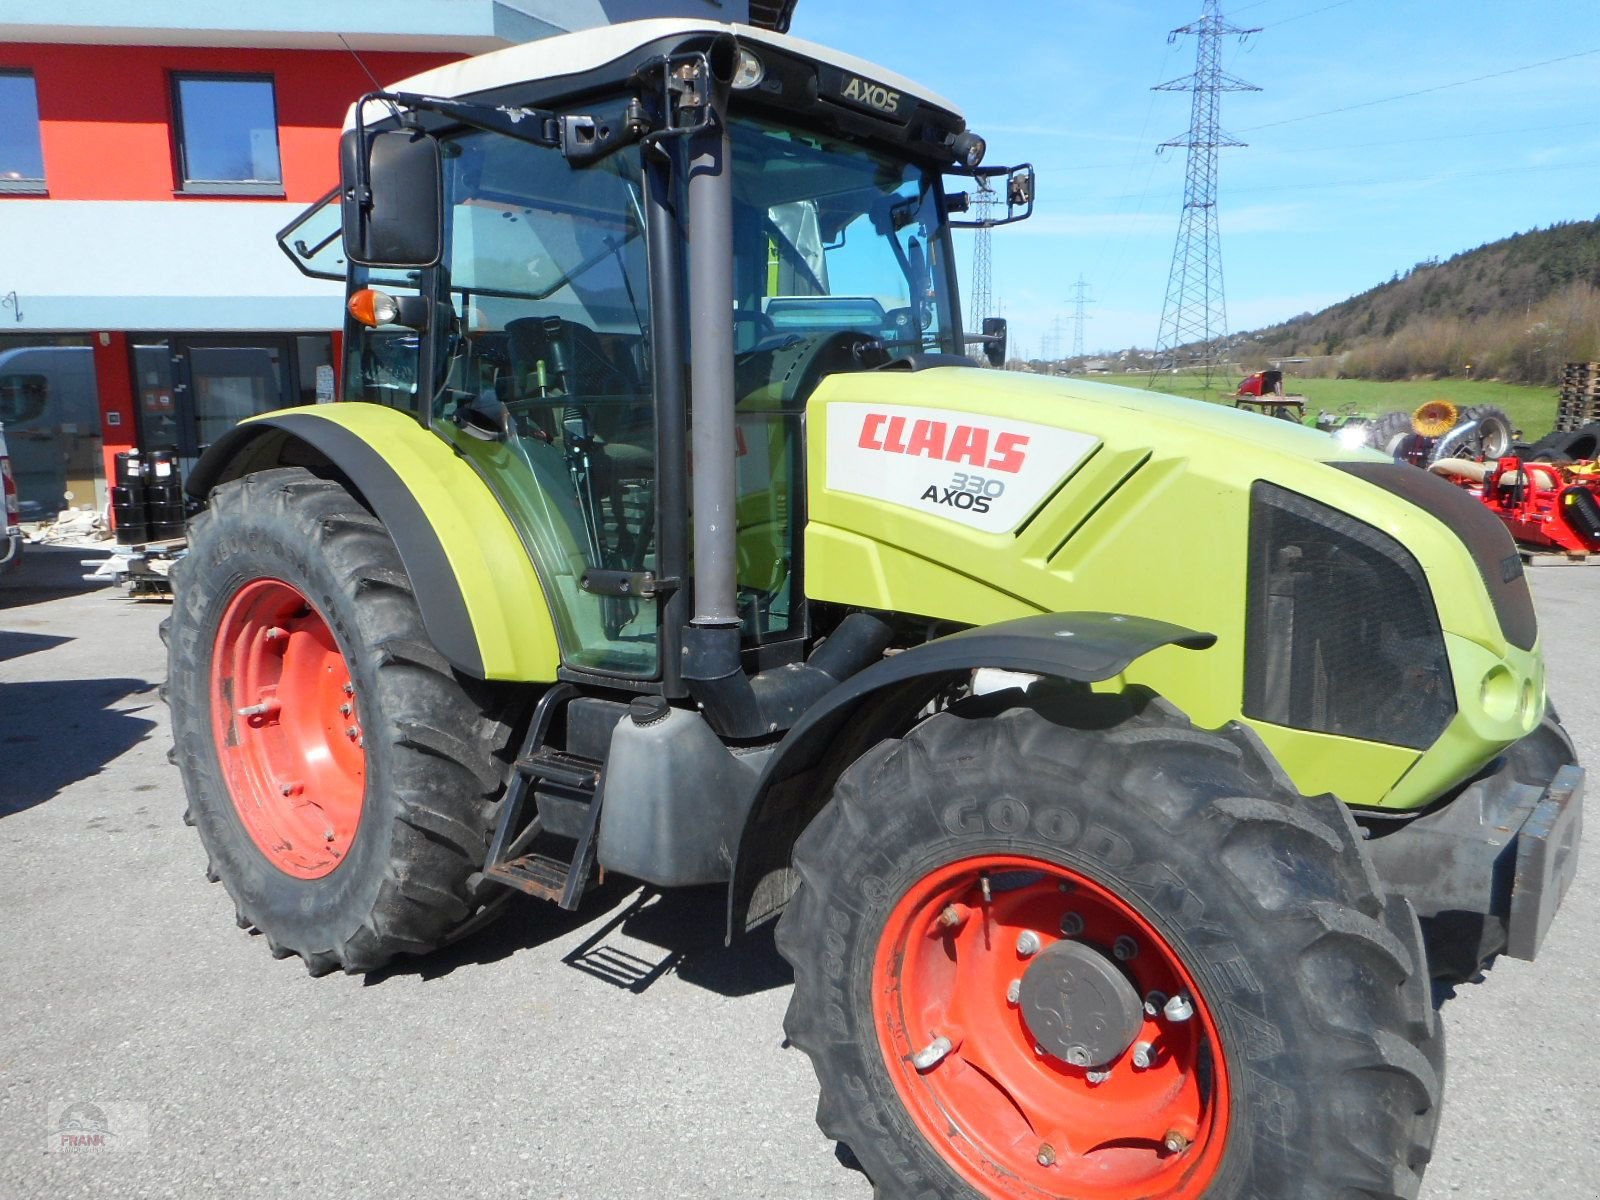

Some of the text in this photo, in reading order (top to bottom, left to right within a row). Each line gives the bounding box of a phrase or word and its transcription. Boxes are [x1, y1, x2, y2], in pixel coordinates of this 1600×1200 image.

[843, 78, 901, 113] AXOS
[858, 413, 1030, 474] CLAAS
[920, 485, 992, 514] AXOS
[949, 471, 1005, 499] 330
